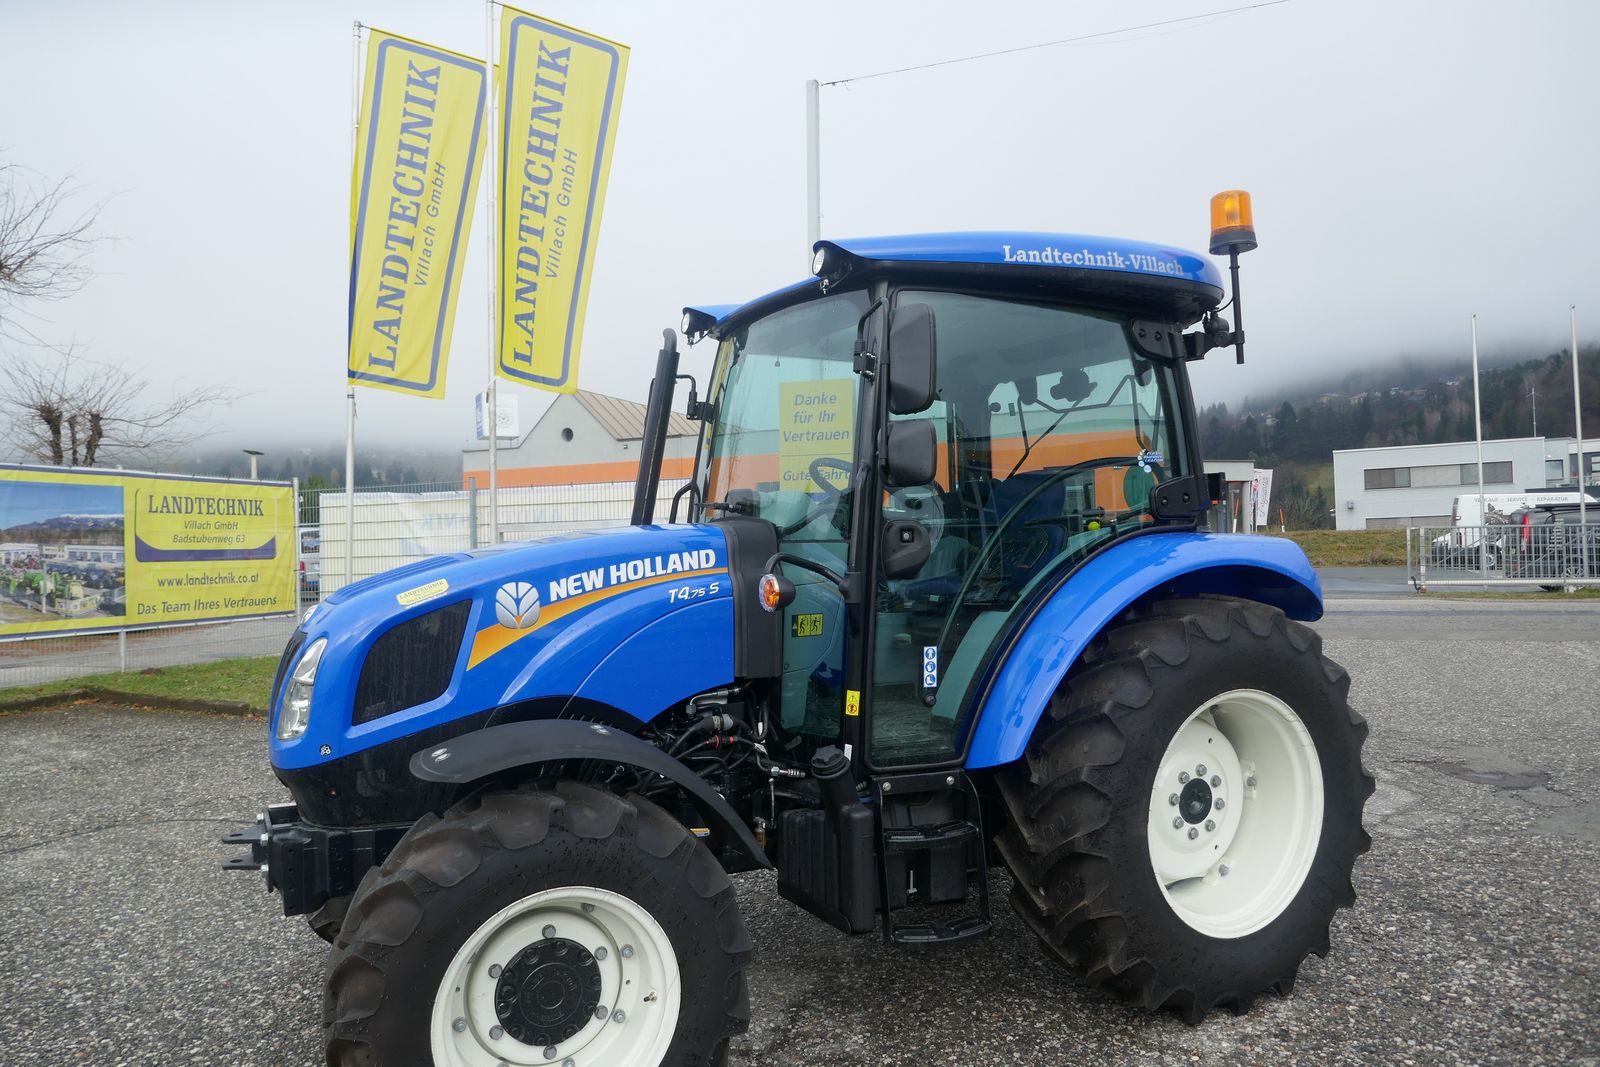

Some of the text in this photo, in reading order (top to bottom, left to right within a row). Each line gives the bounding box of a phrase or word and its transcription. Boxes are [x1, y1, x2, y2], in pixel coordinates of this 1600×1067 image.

[513, 40, 572, 367] LANDTECHNIK
[368, 59, 441, 372] LANDTECHNIK
[545, 148, 578, 279] Villach GmbH
[413, 162, 447, 287] Villach GmbH
[1002, 244, 1185, 276] Landtechnik-Villach
[794, 391, 838, 406] Danke
[793, 410, 837, 424] für Ihr
[782, 430, 850, 442] Vertrauen
[783, 470, 812, 481] Gute
[148, 494, 264, 516] LANDTECHNIK
[184, 520, 239, 530] Villach GmbH
[172, 534, 245, 545] Badstubenweg 63
[157, 572, 259, 587] www.landtechnik.co.at
[550, 548, 716, 602] NEW HOLLAND
[709, 581, 720, 595] S
[137, 595, 277, 615] Das Team Ihres Vertrauens
